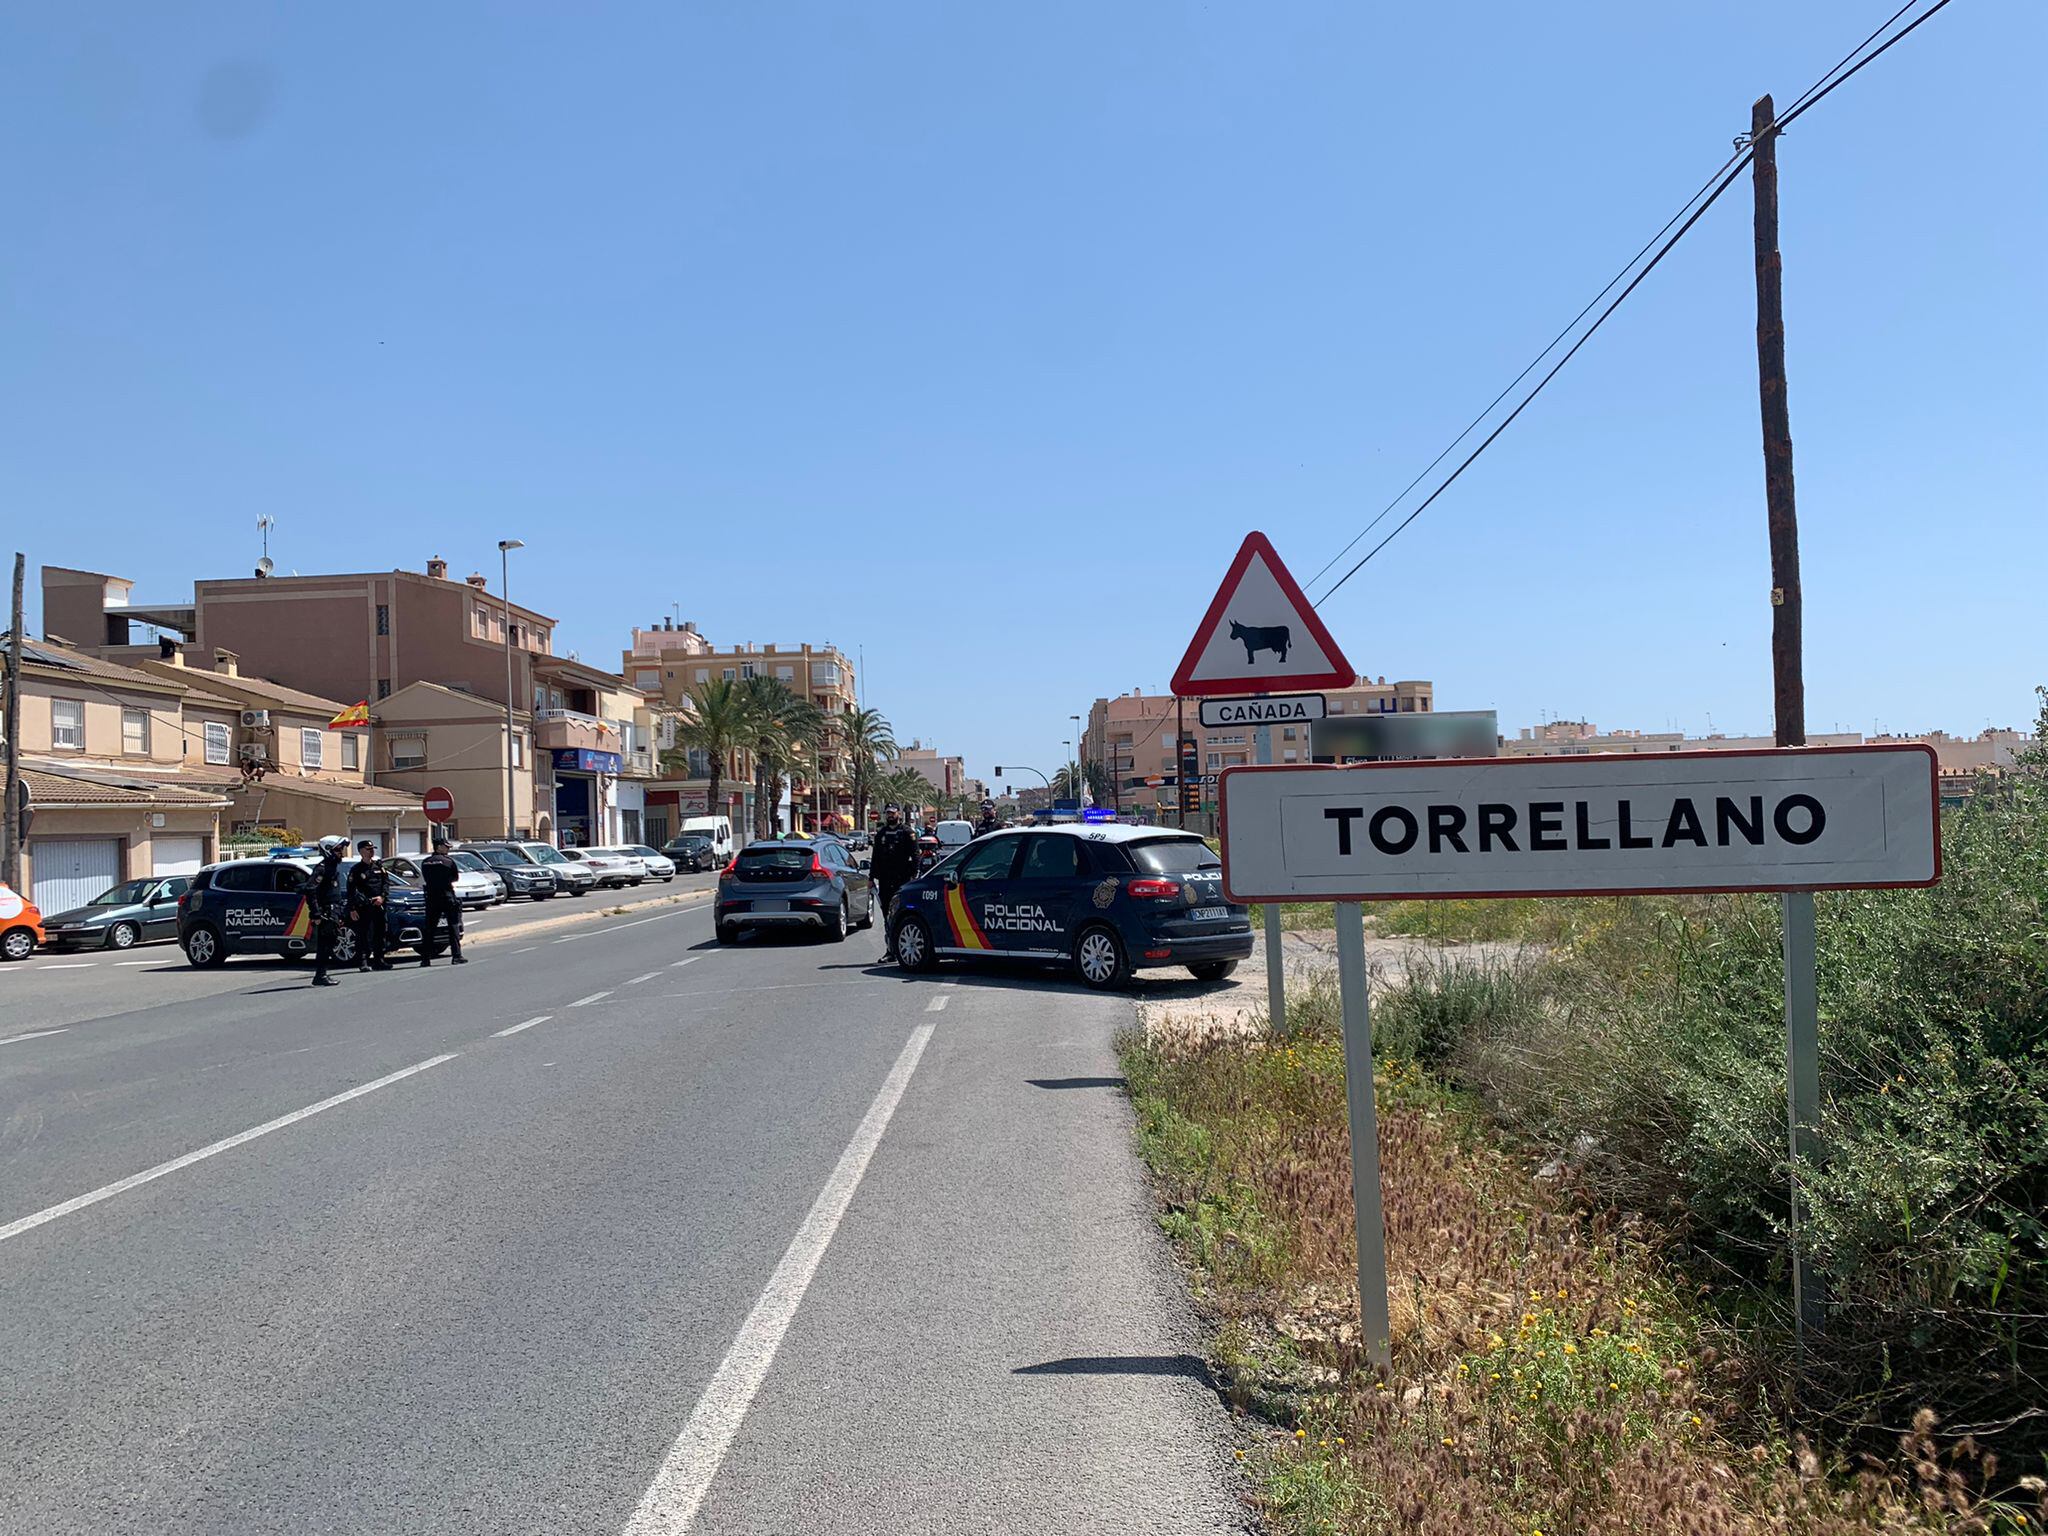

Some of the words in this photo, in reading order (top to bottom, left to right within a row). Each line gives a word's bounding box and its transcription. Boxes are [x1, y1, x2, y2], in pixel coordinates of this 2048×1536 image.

[1219, 702, 1306, 721] CAÑADA
[1324, 793, 1827, 856] TORRELLANO
[225, 917, 285, 926] NACIONAL
[984, 918, 1064, 932] NACIONAL
